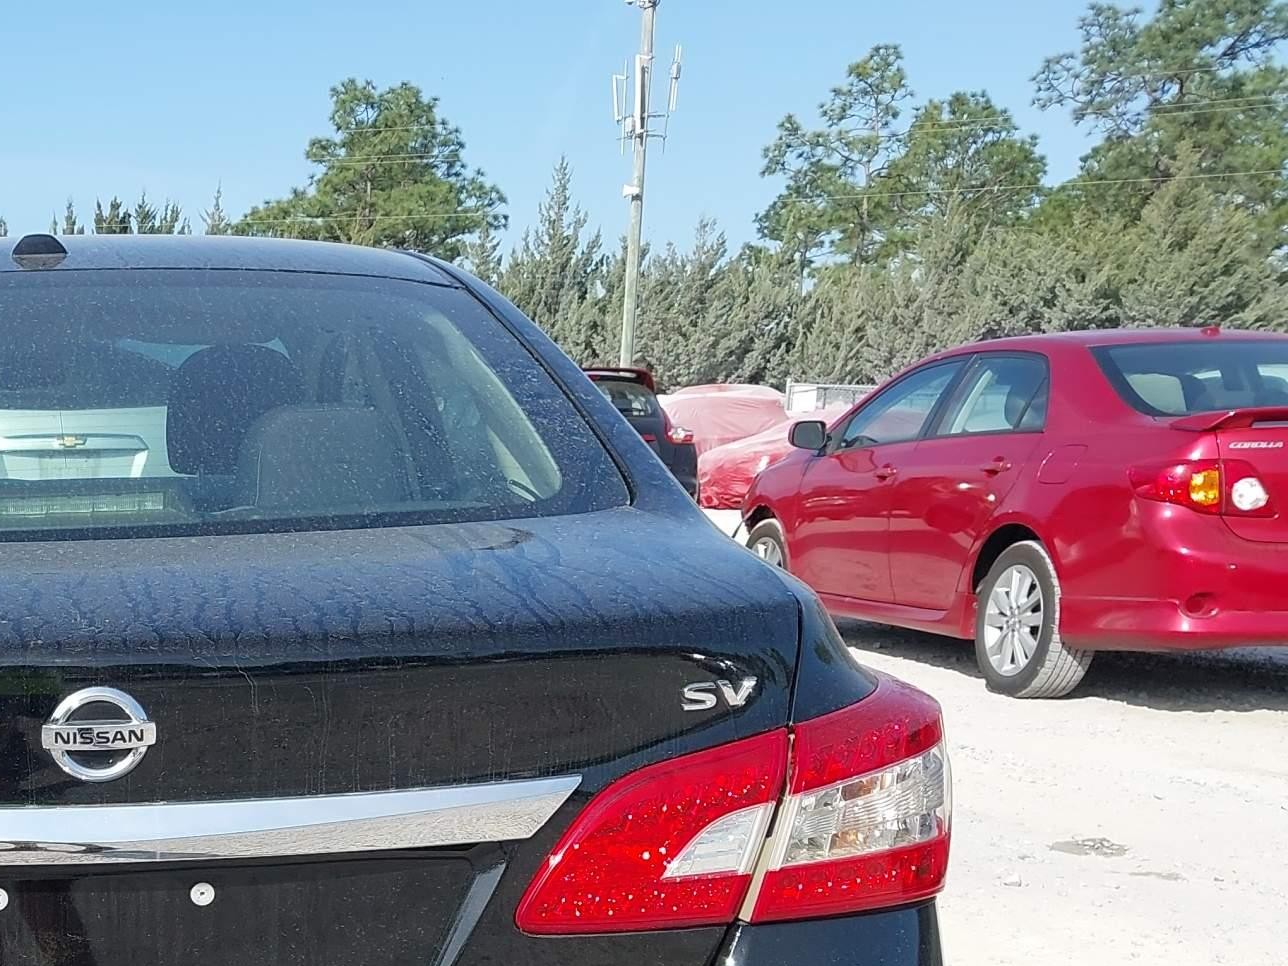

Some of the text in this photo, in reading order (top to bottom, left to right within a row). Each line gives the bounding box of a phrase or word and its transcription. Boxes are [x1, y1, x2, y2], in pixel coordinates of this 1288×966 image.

[1229, 441, 1284, 449] COROLLA
[680, 676, 758, 711] SV
[54, 728, 144, 745] NISSAN
